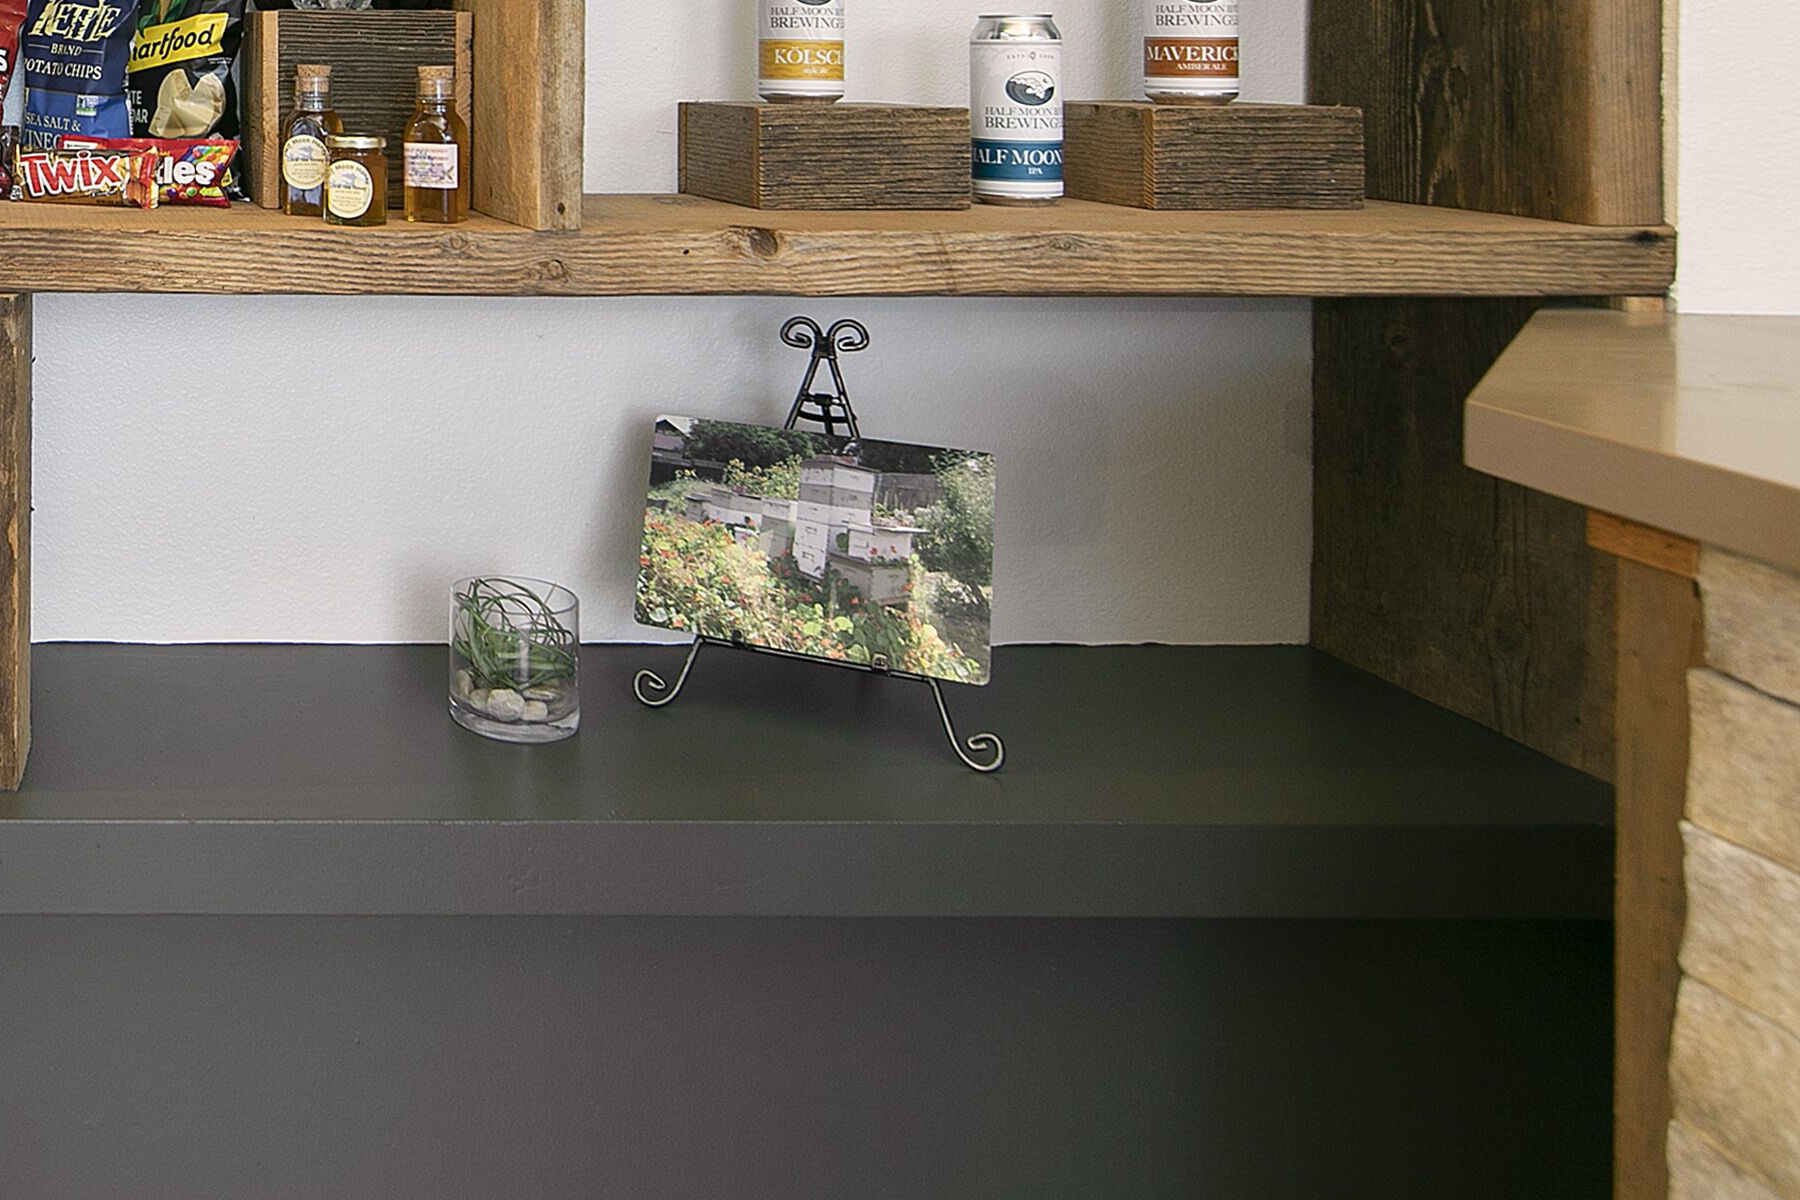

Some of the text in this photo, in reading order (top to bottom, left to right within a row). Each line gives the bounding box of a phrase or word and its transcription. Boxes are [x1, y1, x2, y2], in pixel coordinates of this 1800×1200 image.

[771, 7, 801, 16] HALF
[802, 7, 834, 16] MOON
[1155, 5, 1224, 13] HALF MOON
[770, 16, 839, 29] BREWING
[1155, 14, 1232, 26] BREWING
[64, 62, 103, 80] CHIPS
[985, 107, 1053, 116] HALF MOON
[25, 112, 81, 132] SEA SALT &
[985, 117, 1059, 129] BREWING
[1028, 167, 1044, 175] IPA
